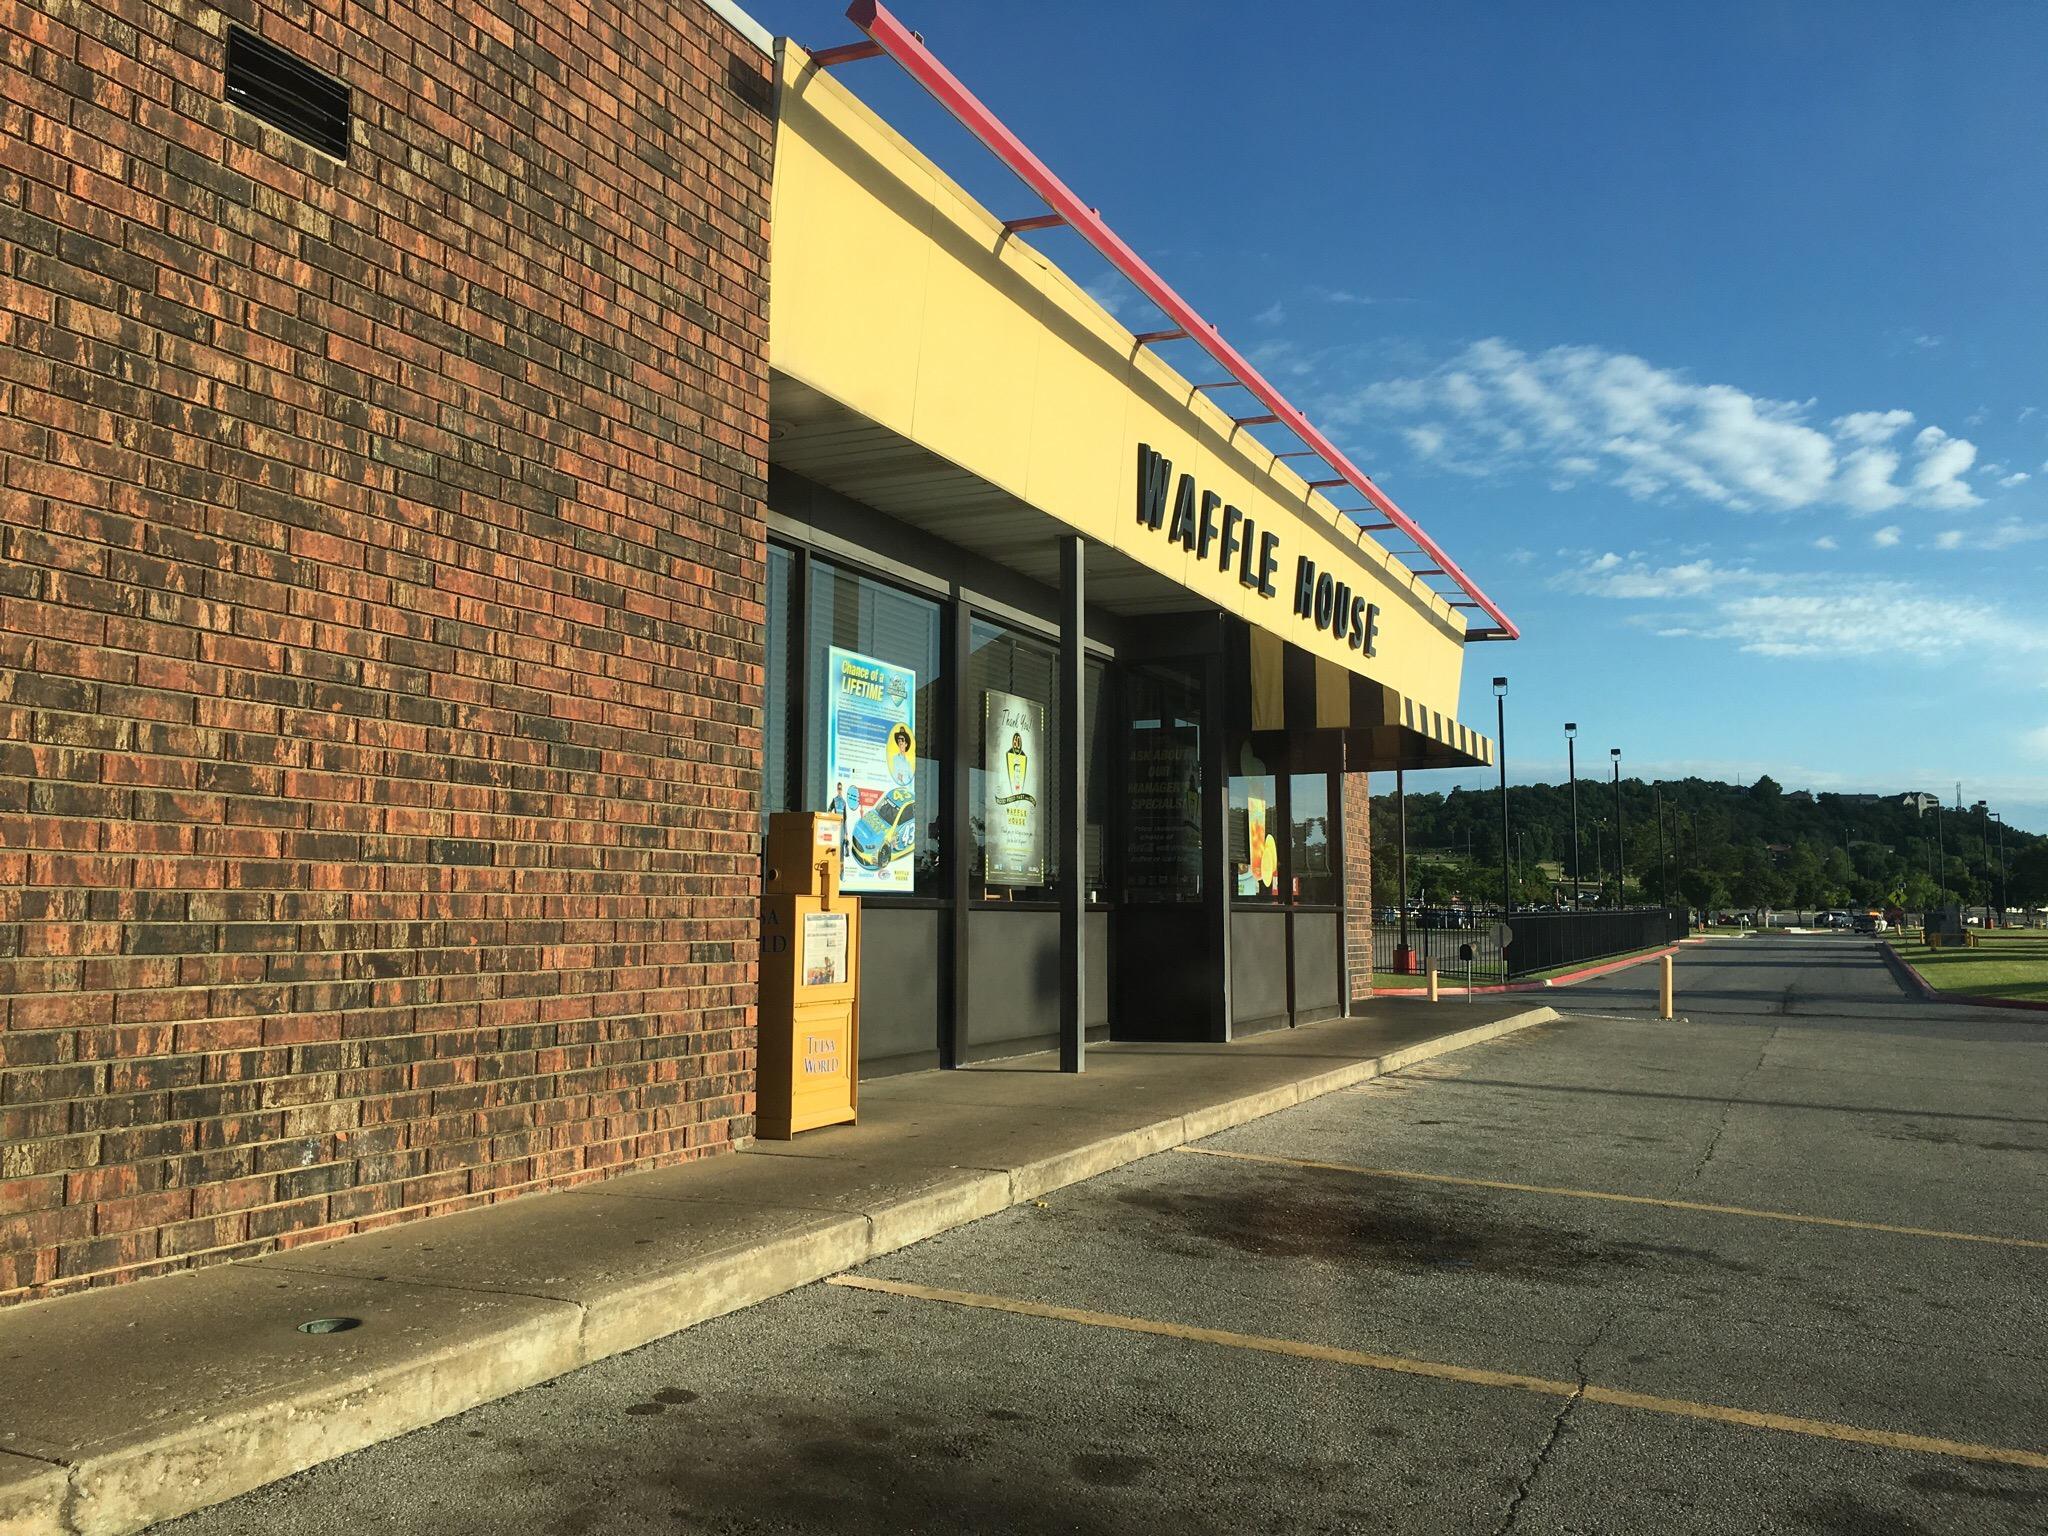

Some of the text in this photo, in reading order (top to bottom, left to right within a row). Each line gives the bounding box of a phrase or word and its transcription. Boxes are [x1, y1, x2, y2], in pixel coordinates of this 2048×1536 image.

[1137, 442, 1380, 658] WAFFLE HOUSE
[842, 660, 885, 683] Chance of a
[842, 676, 884, 702] LIFETIME
[1002, 709, 1019, 729] Thank
